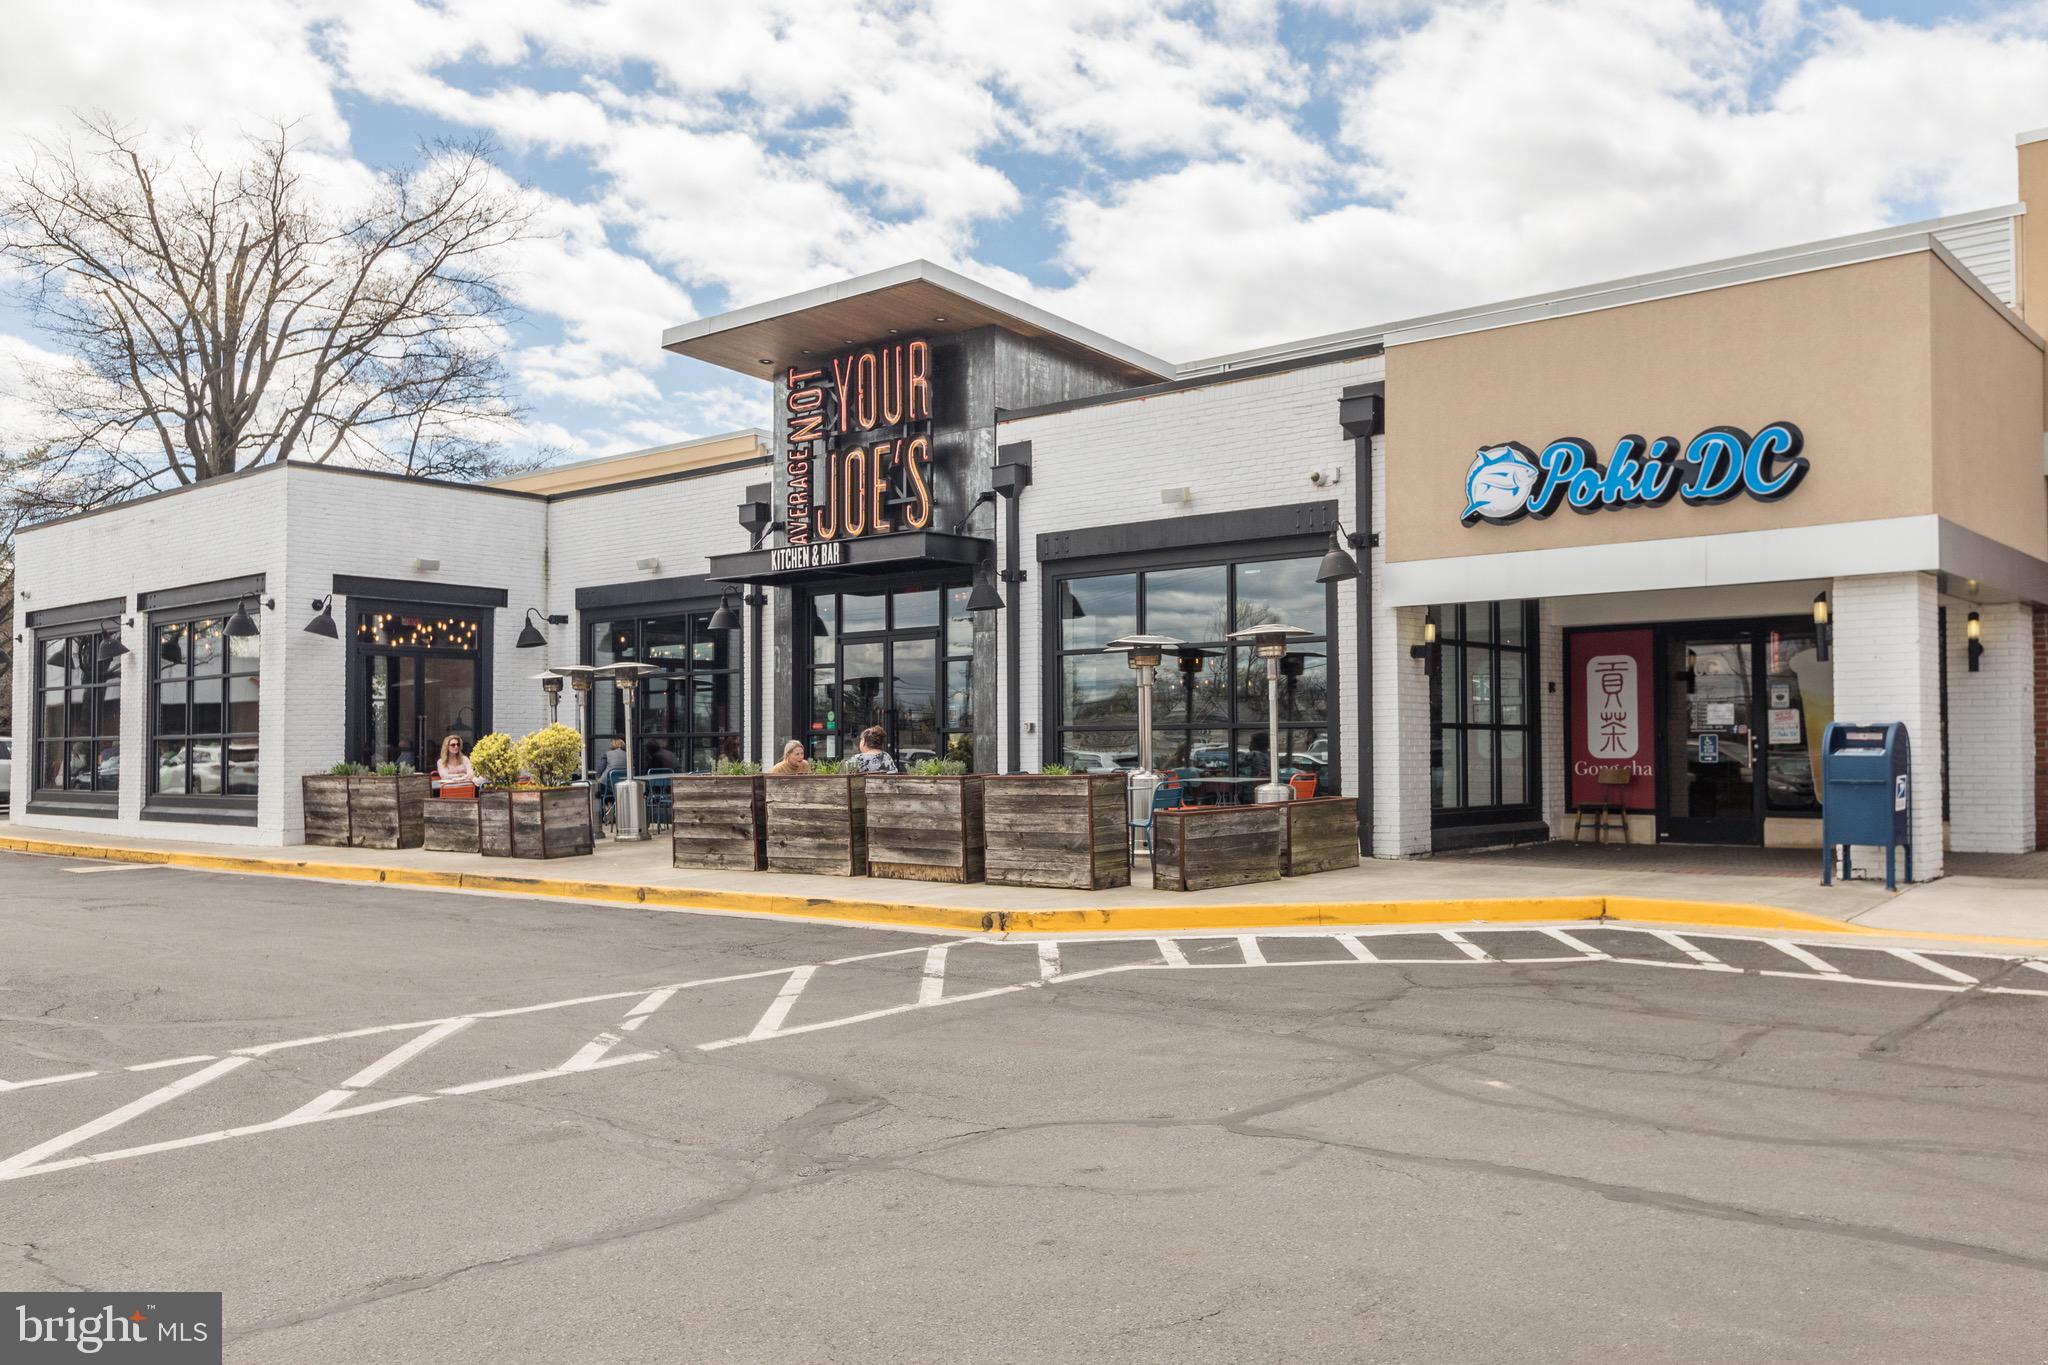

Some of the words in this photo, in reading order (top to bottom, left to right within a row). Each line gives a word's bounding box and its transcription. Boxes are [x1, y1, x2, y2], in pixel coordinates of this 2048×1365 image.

[788, 367, 824, 443] NOT
[832, 340, 930, 433] YOUR
[788, 447, 810, 545] AVERAGE
[816, 436, 931, 539] JOE'S
[1526, 437, 1676, 513] Poki
[1680, 425, 1801, 499] DC
[771, 546, 810, 572] KITCHEN
[812, 545, 820, 566] &
[821, 542, 840, 565] BAR
